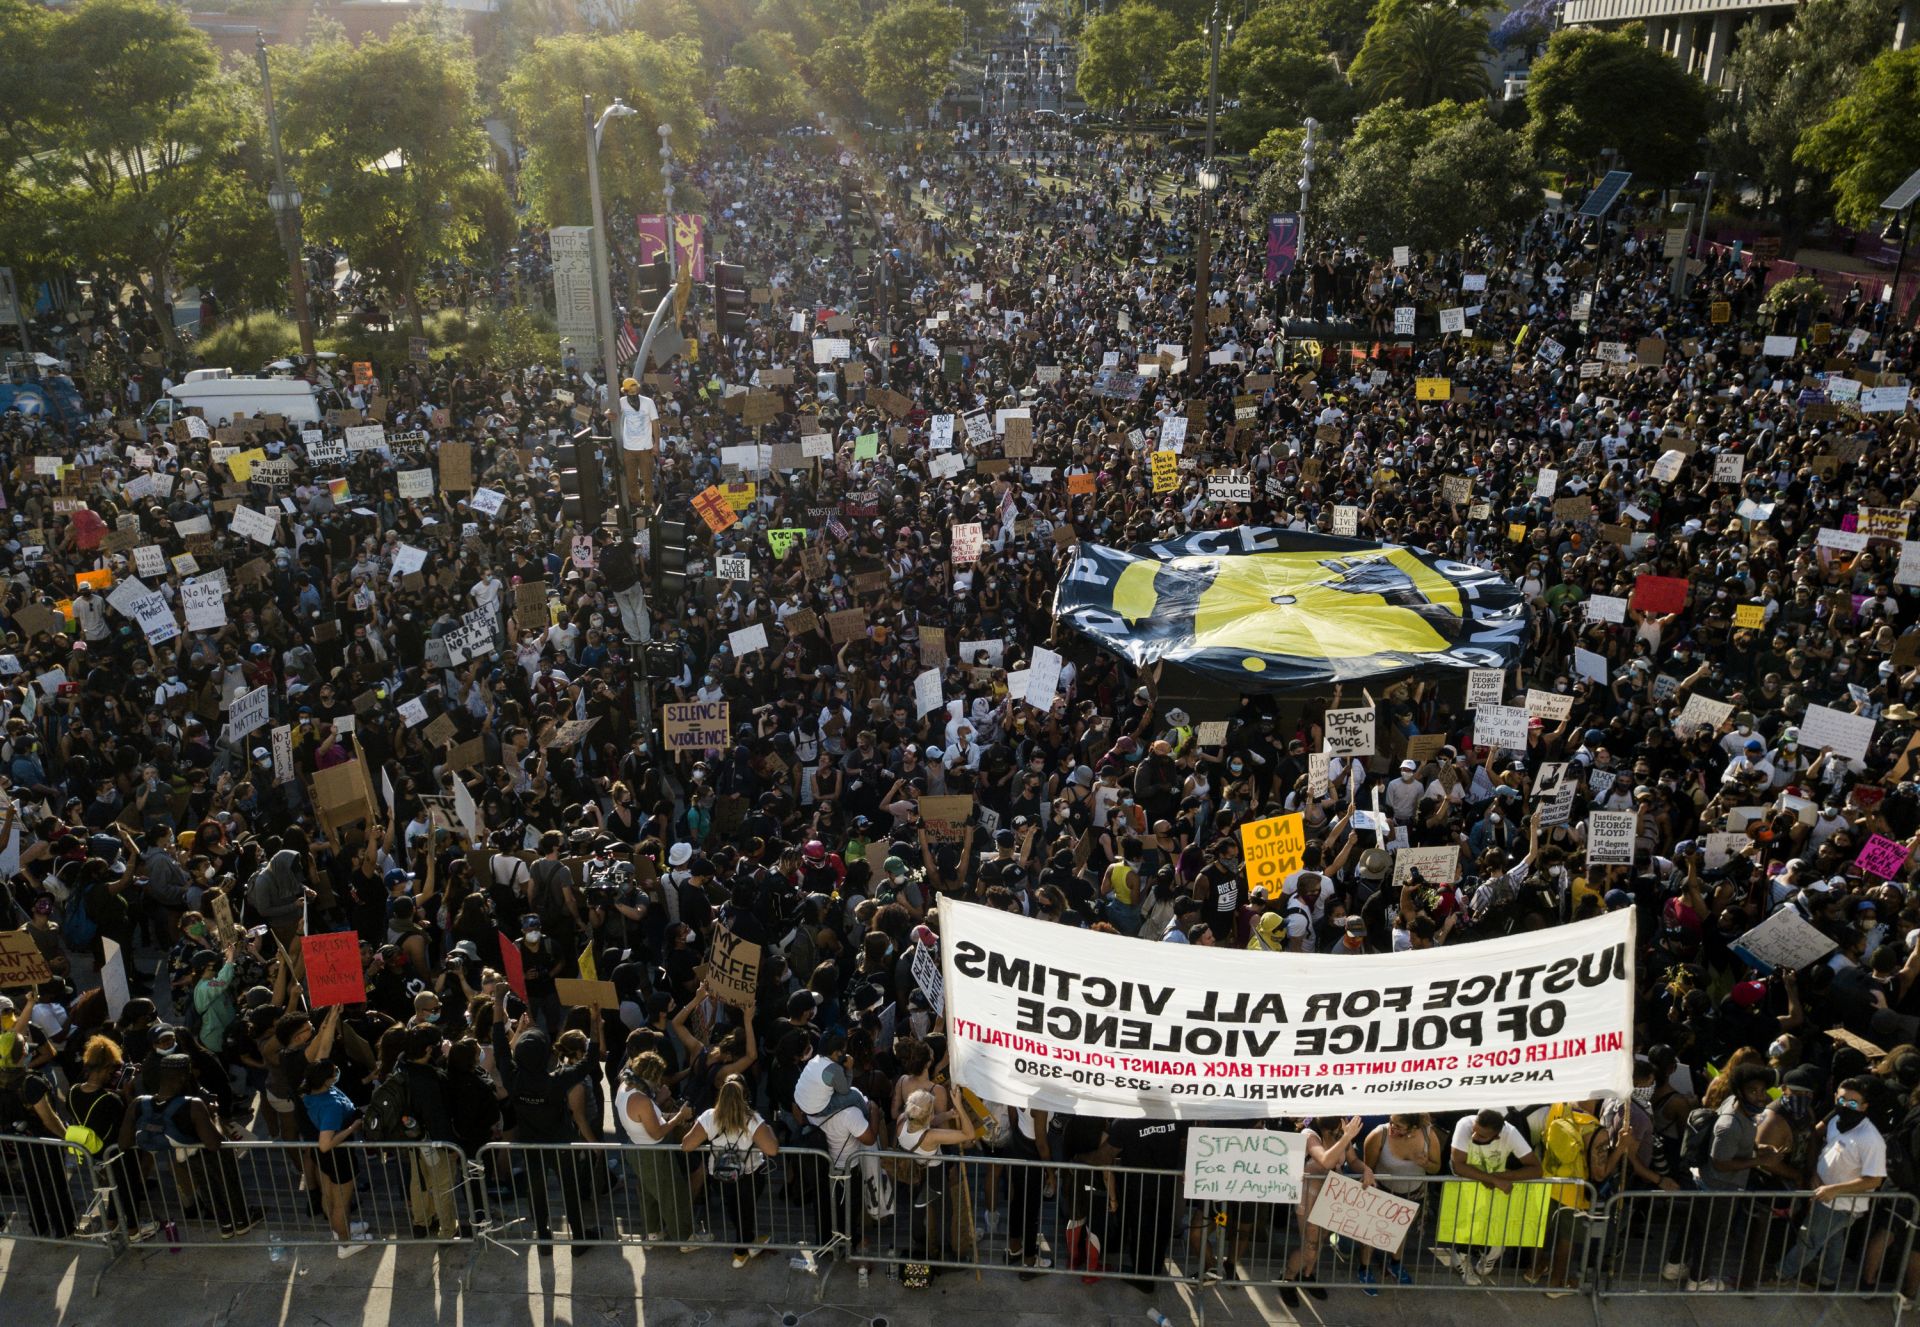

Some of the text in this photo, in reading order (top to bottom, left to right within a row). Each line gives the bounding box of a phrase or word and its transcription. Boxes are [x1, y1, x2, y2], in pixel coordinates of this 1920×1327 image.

[395, 432, 423, 441] RACE
[316, 440, 337, 449] END
[311, 447, 343, 457] WHITE
[1717, 454, 1739, 464] BLACK
[259, 468, 288, 476] JAMES
[252, 474, 289, 484] SCURLOCK
[1208, 475, 1249, 484] DEFUND
[1209, 489, 1251, 498] POLICE!
[53, 500, 78, 513] BLM
[1335, 508, 1356, 517] BLACK
[1335, 518, 1356, 526] LIVES
[720, 570, 746, 579] MATTER
[183, 584, 220, 599] No More
[184, 599, 205, 611] Killer
[465, 606, 490, 624] BLACK
[445, 625, 475, 643] COLOR
[447, 629, 482, 652] NOT A
[230, 688, 267, 720] BLACK LIVES
[667, 702, 727, 722] SILENCE
[1477, 705, 1528, 717] WHITE PEOPLE
[233, 707, 264, 736] MATTER
[1327, 712, 1375, 726] DEFUND
[1476, 716, 1489, 724] ARE
[1492, 718, 1511, 727] SICK
[1335, 725, 1362, 735] THE
[1475, 727, 1496, 736] WHITE
[273, 732, 283, 745] NO
[669, 730, 728, 746] VIOLENCE
[1480, 735, 1518, 748] BULLSHIT
[1594, 813, 1622, 822] Justice
[1593, 821, 1633, 829] GEORGE
[1593, 839, 1629, 849] 1st degree
[1597, 847, 1631, 856] Chauvin!
[1217, 880, 1238, 895] RISE UP
[713, 923, 746, 955] MY
[310, 940, 354, 953] RACISM
[323, 953, 339, 962] IS
[710, 944, 758, 982] LIFE
[327, 966, 337, 974] A
[916, 948, 926, 982] BLACK
[706, 964, 757, 995] MATTERS
[921, 958, 934, 990] LIVES
[1139, 1122, 1176, 1138] LOCKED IN
[1196, 1134, 1290, 1158] STAND
[1233, 1159, 1262, 1175] ALL
[1267, 1161, 1290, 1175] OR
[1224, 1179, 1298, 1199] 4 Anything
[1324, 1176, 1411, 1226] RACIST COPS
[1329, 1200, 1390, 1232] GO TO
[1328, 1214, 1378, 1243] HELL
